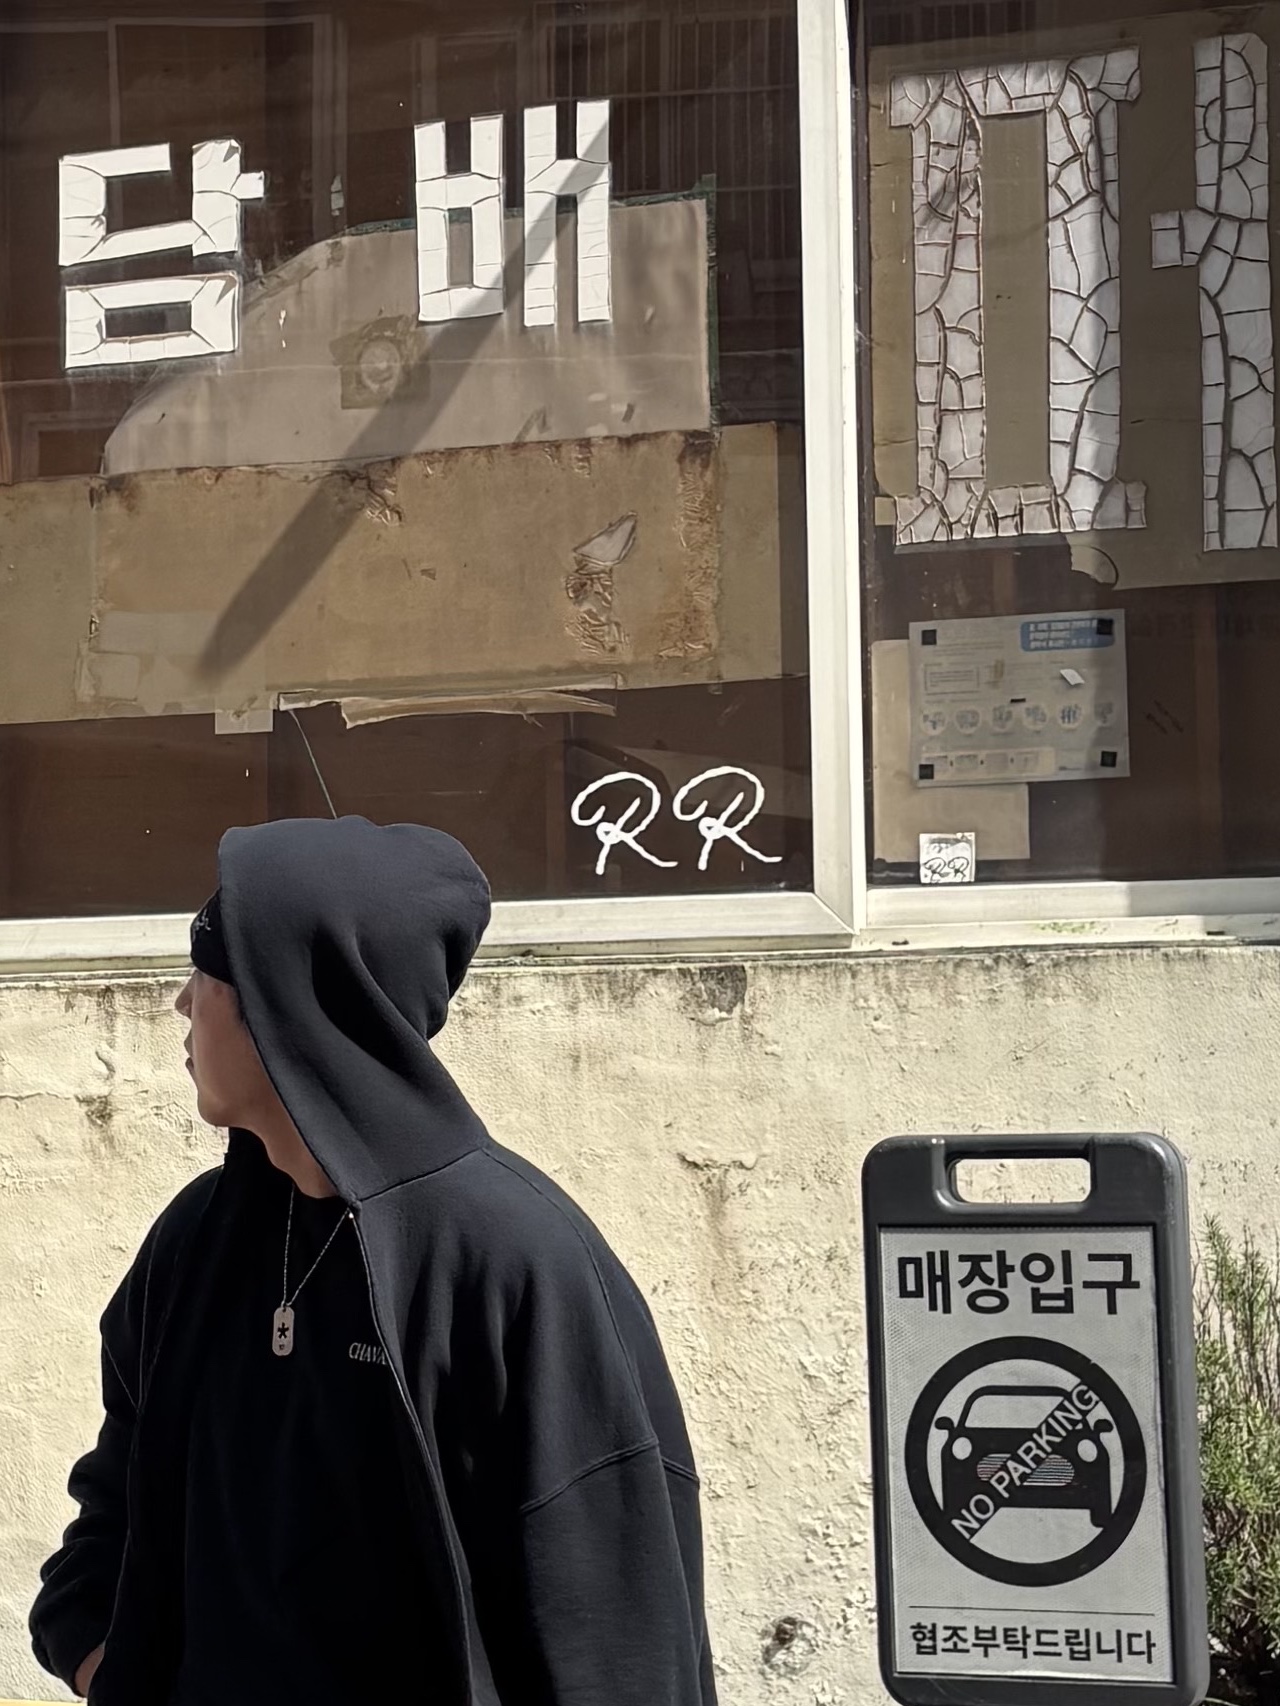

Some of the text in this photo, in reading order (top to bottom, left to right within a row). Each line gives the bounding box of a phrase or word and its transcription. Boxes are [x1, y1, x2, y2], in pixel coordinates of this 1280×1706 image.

[57, 99, 611, 369] 담배
[571, 765, 783, 876] RR
[898, 1249, 1141, 1316] 매장입구
[951, 1384, 1101, 1540] NO PARKING
[910, 1621, 1157, 1665] 협조부탁드립니다
